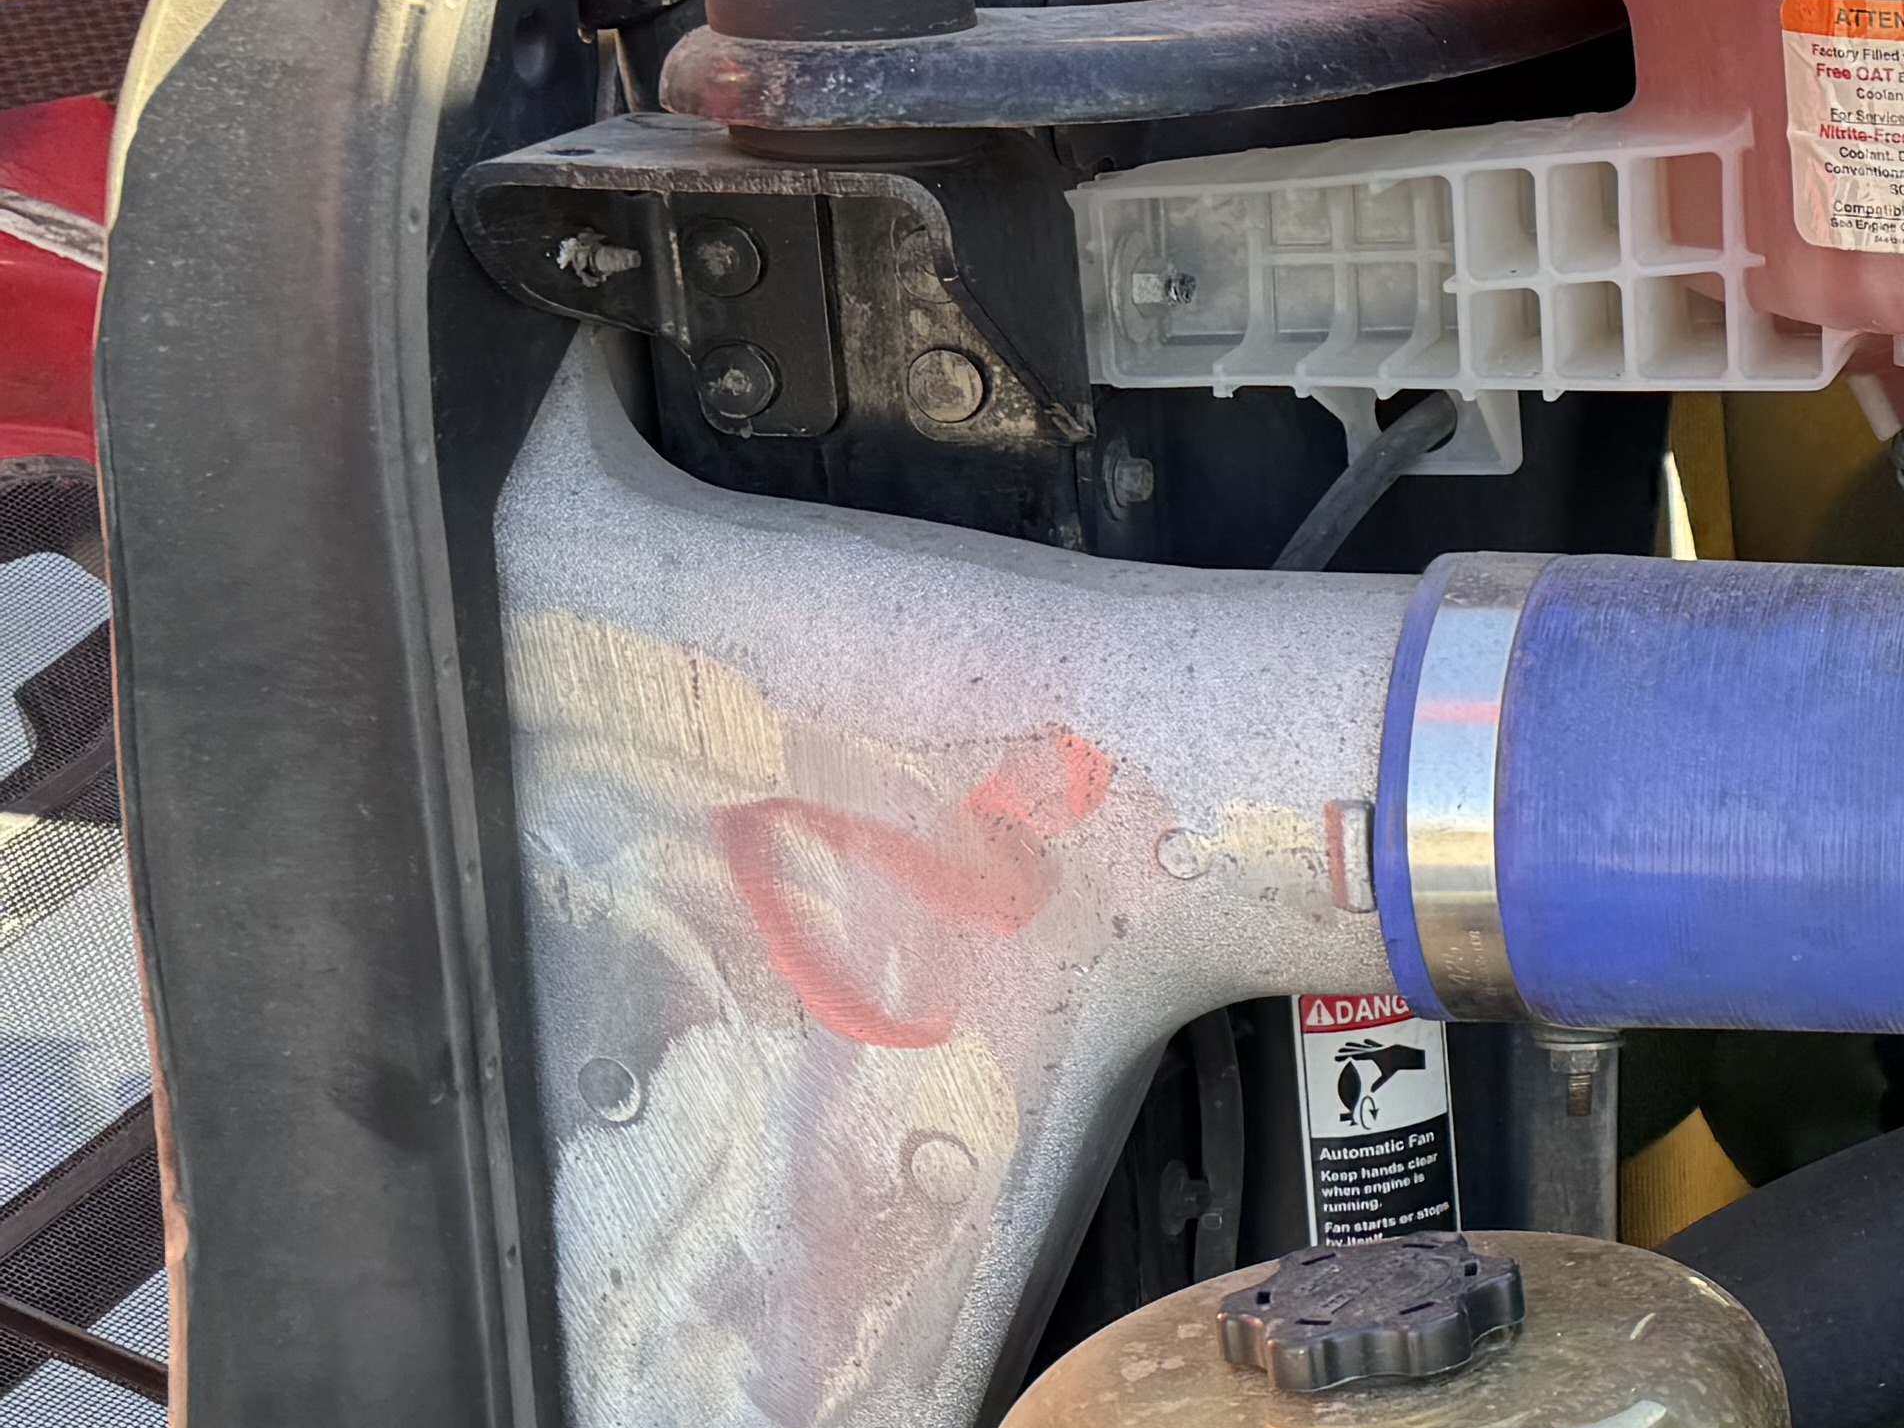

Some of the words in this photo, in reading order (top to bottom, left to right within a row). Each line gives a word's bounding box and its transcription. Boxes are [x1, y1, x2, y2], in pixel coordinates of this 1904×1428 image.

[1812, 43, 1859, 63] Factory
[1862, 47, 1900, 62] Filled
[1816, 63, 1851, 80] Free
[1856, 66, 1895, 83] OAT
[1830, 108, 1853, 123] For
[1839, 147, 1895, 162] Coolant.
[1336, 995, 1410, 1025] DANG
[1319, 1139, 1405, 1161] Automatic
[1408, 1131, 1435, 1149] Fan
[1320, 1169, 1358, 1184] Keep
[1361, 1162, 1404, 1179] hands
[1407, 1152, 1438, 1170] clear
[1321, 1184, 1361, 1197] when
[1363, 1176, 1411, 1196] engine
[1413, 1172, 1425, 1184] is
[1323, 1198, 1383, 1214] running.
[1324, 1220, 1352, 1235] Fan
[1354, 1215, 1396, 1233] starts
[1399, 1213, 1414, 1225] or
[1416, 1201, 1450, 1222] stops
